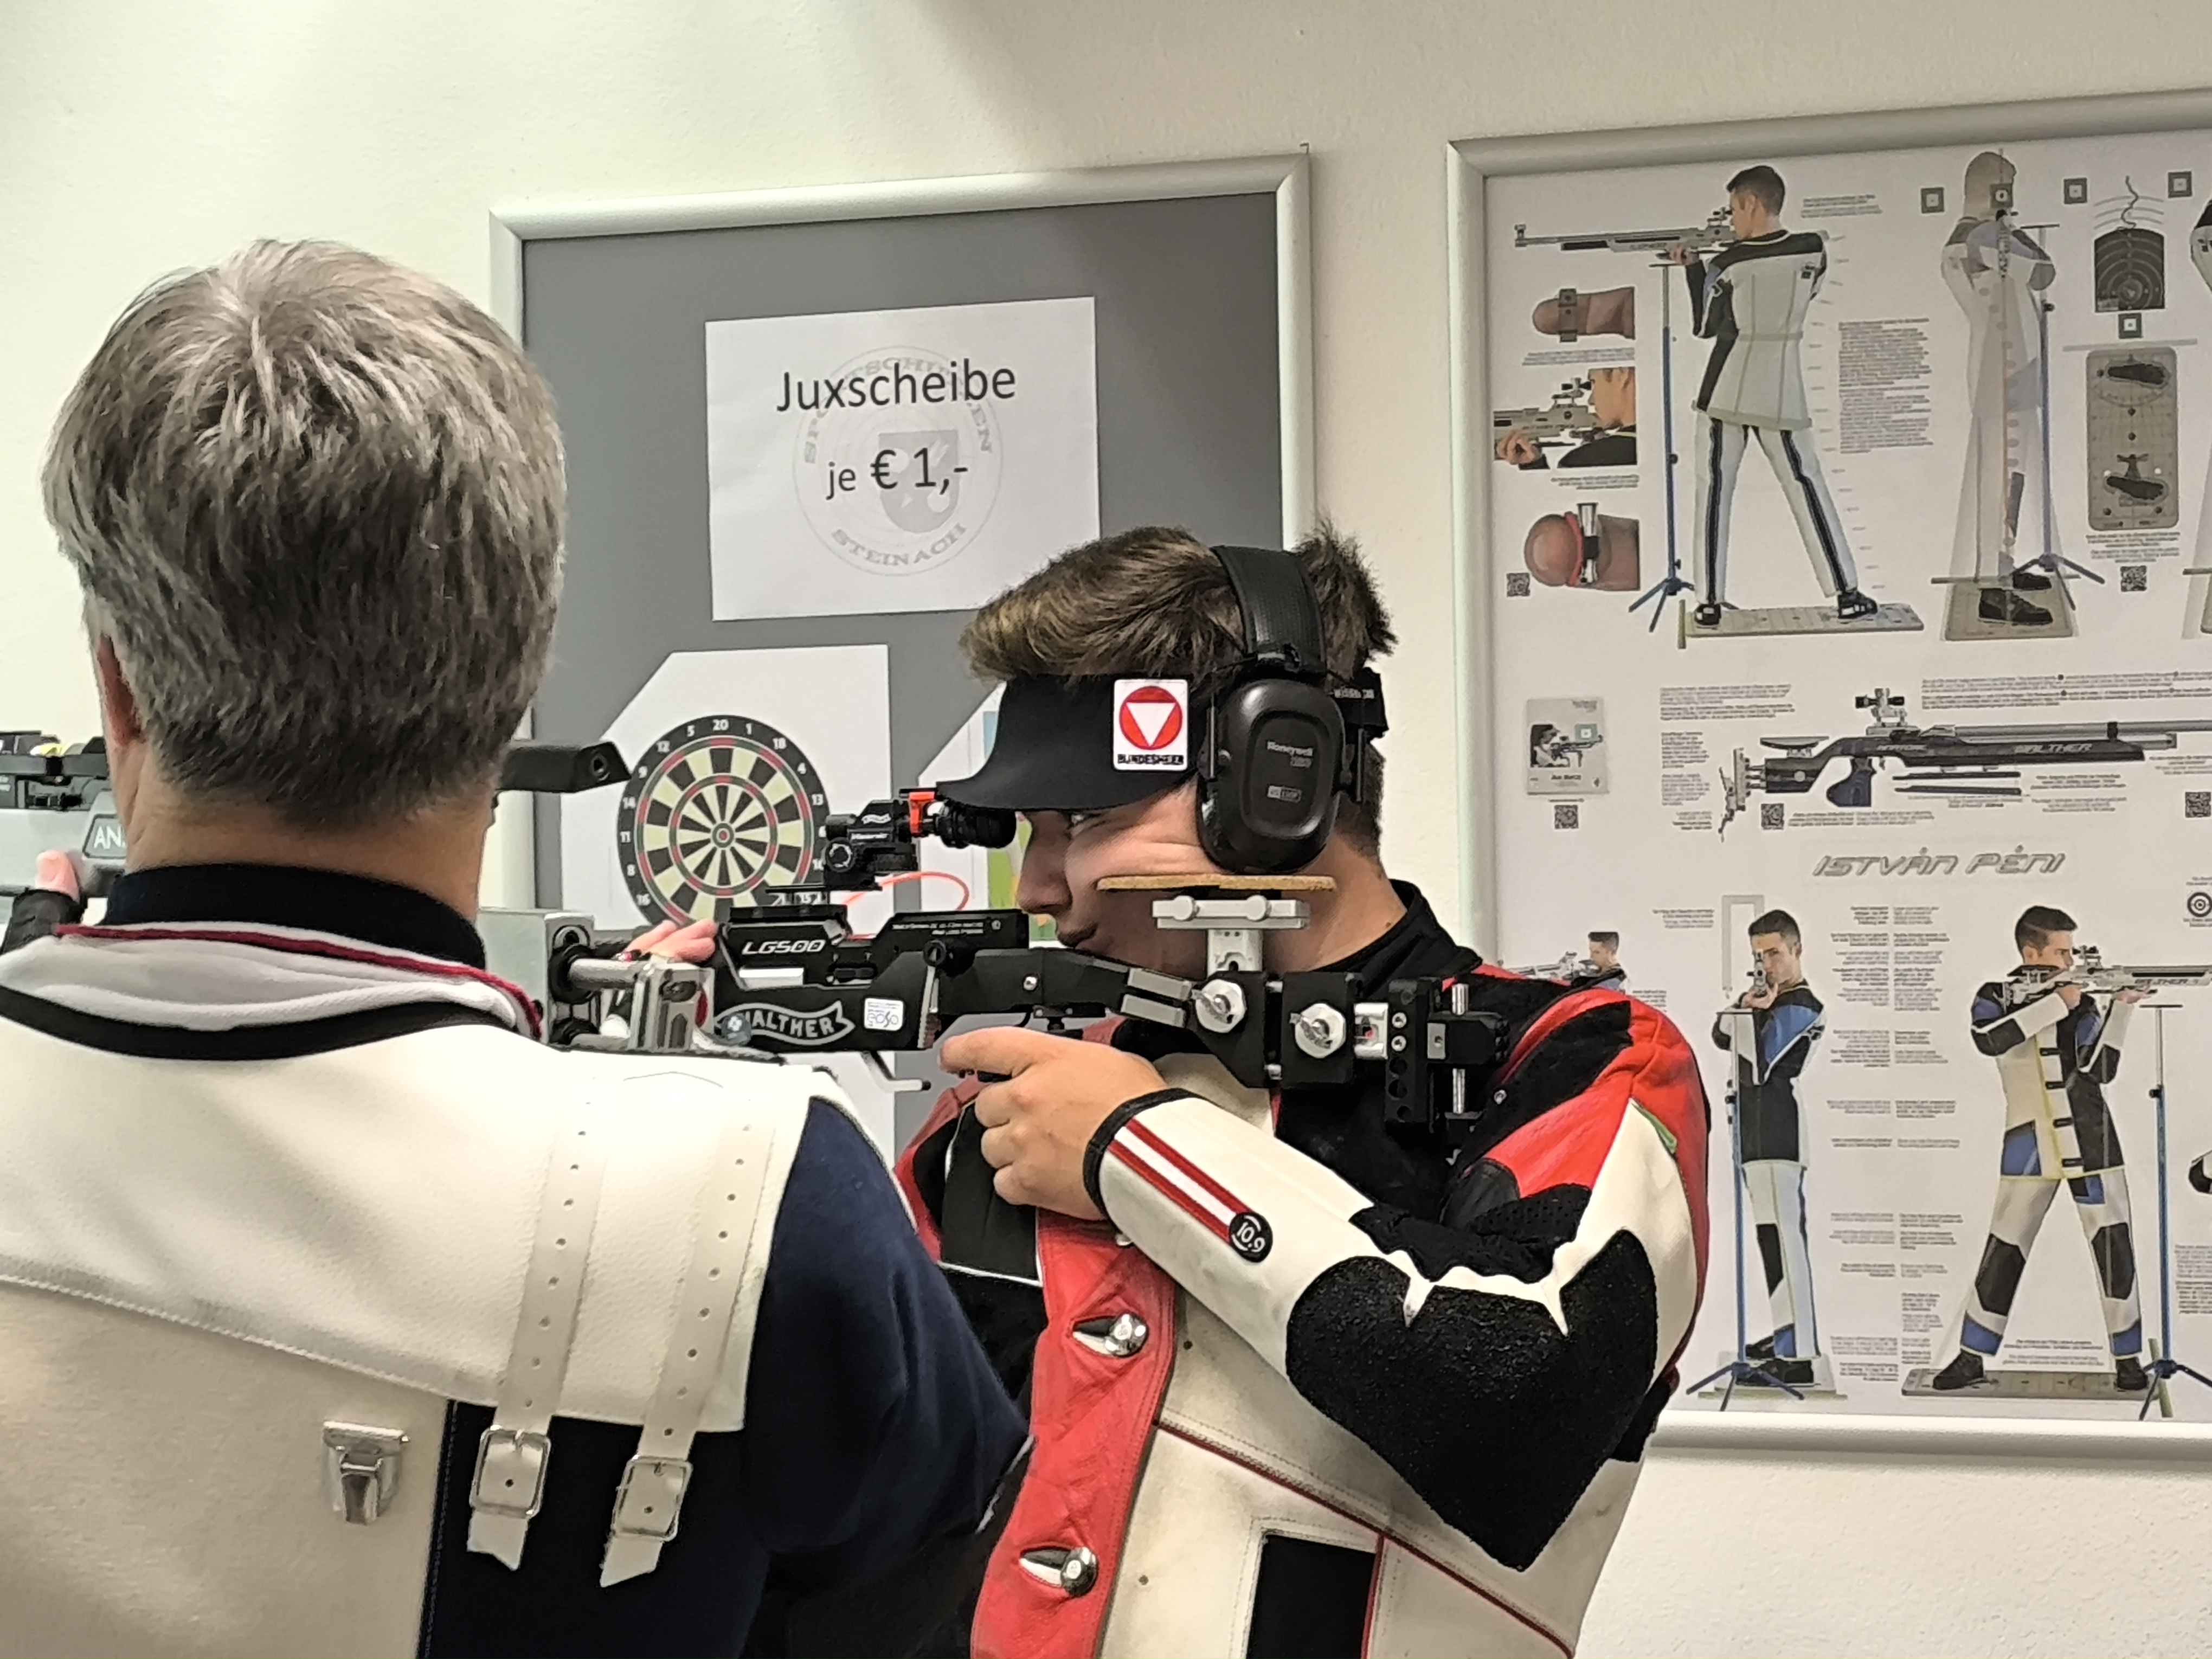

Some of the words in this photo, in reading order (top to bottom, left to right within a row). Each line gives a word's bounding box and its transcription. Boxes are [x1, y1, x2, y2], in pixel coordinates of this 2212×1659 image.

[777, 358, 1016, 411] Juxscheibe
[826, 461, 857, 500] je
[870, 449, 899, 490] €
[914, 447, 968, 494] 1,-
[832, 522, 967, 566] STEINACH
[687, 725, 695, 737] 5
[712, 719, 729, 731] 20
[745, 723, 753, 735] 1
[657, 741, 670, 753] 12
[772, 737, 787, 749] 18
[638, 766, 648, 779] 9
[797, 762, 807, 774] 4
[623, 796, 636, 809] 14
[812, 794, 824, 806] 13
[94, 826, 126, 850] AN
[620, 831, 631, 843] 11
[627, 864, 635, 877] 8
[636, 893, 651, 906] 16
[742, 939, 826, 955] LG500
[1236, 1221, 1266, 1253] 10.9
